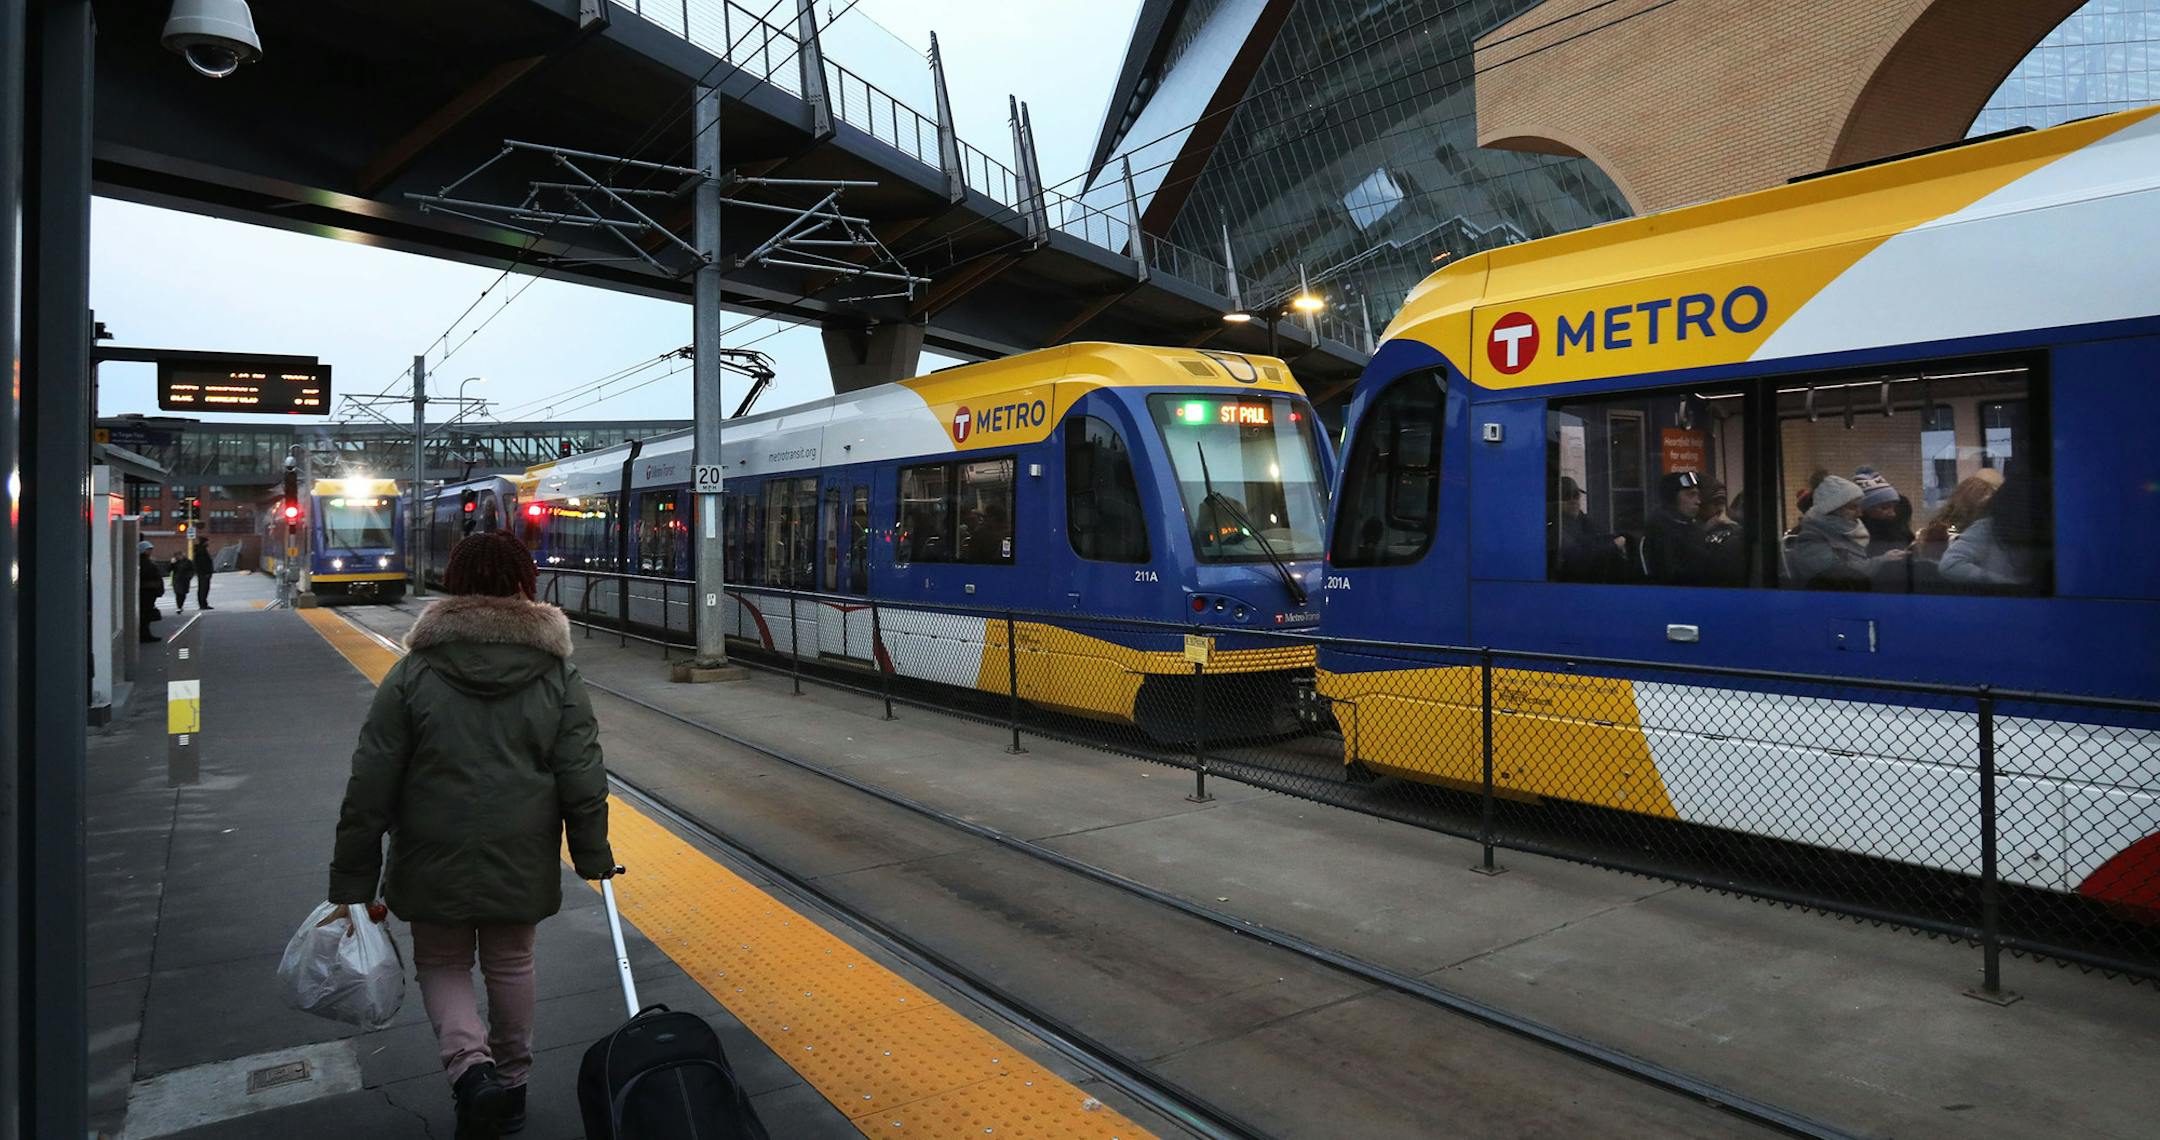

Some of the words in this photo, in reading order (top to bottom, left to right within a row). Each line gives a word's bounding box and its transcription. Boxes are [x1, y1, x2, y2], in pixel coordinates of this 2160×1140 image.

[1557, 285, 1768, 356] METRO
[976, 399, 1046, 434] METRO
[1220, 405, 1237, 422] ST
[1239, 406, 1269, 424] PAUL
[699, 467, 720, 484] 20
[1135, 570, 1159, 582] 211A
[1327, 576, 1351, 590] 201A
